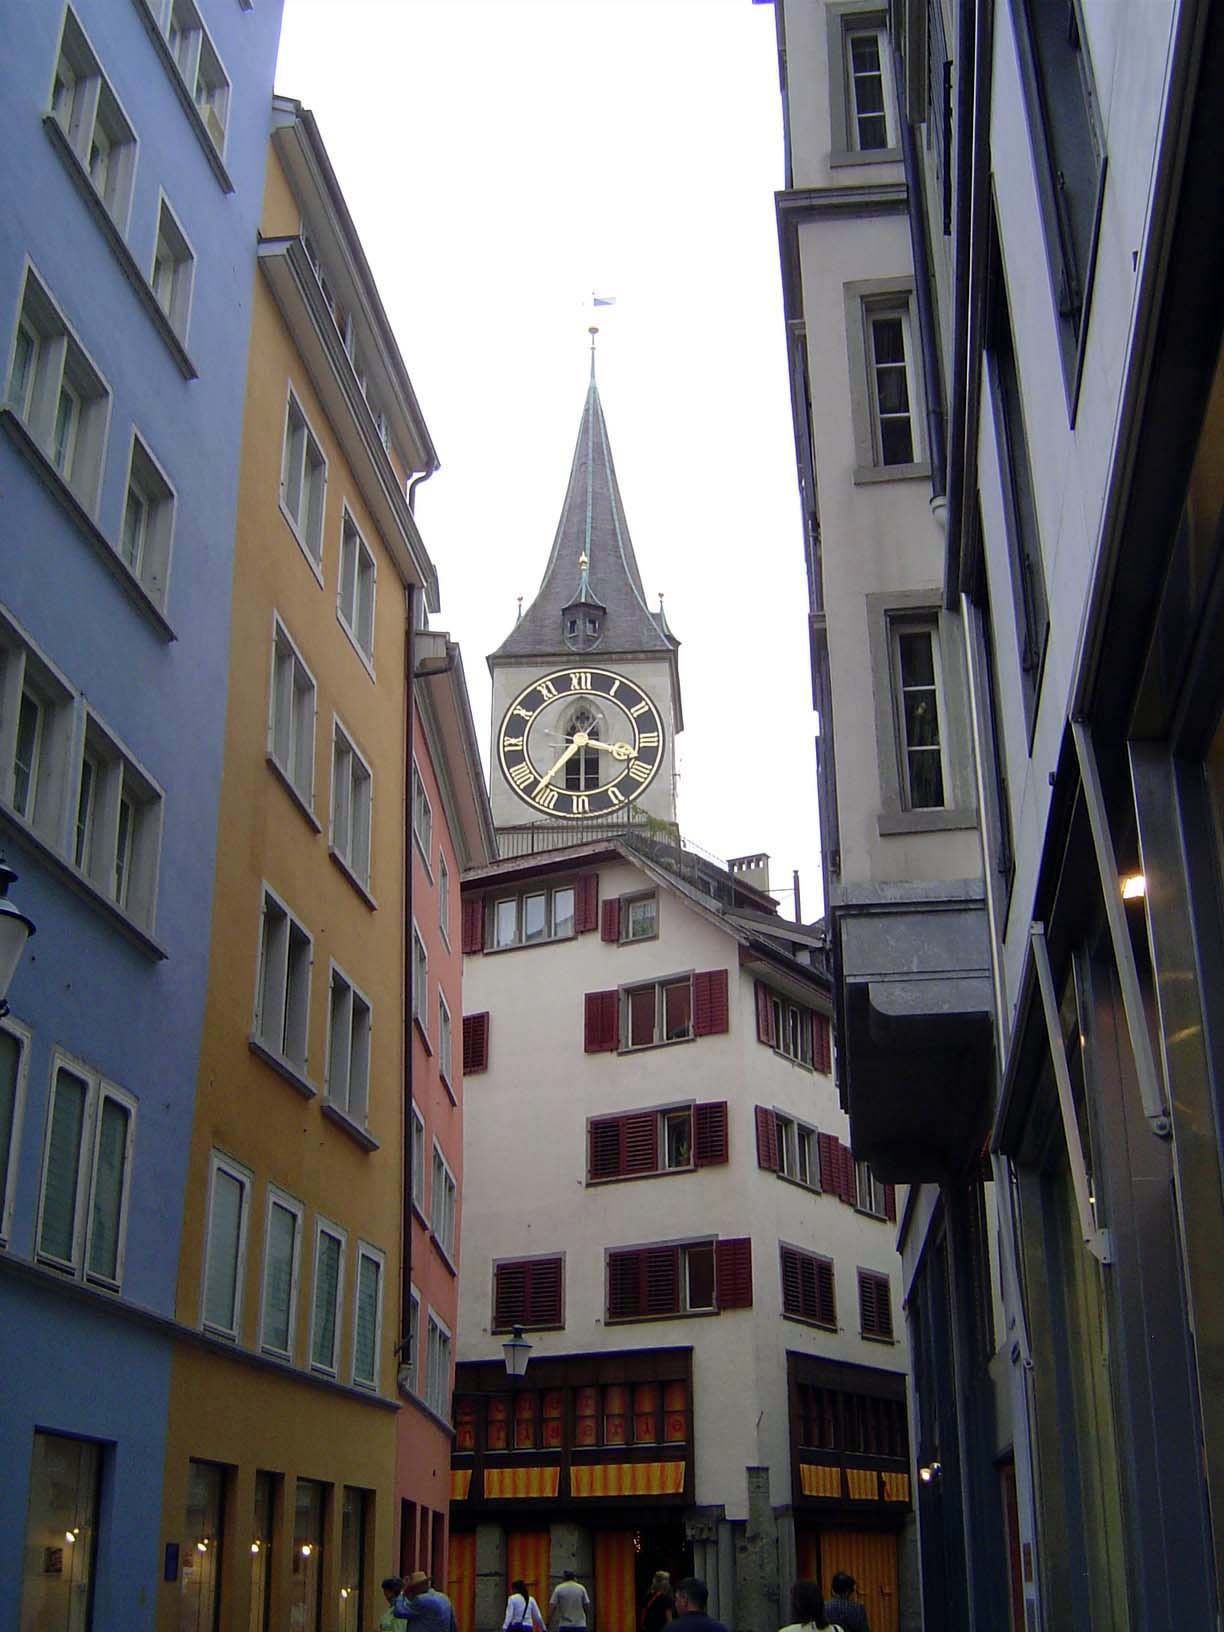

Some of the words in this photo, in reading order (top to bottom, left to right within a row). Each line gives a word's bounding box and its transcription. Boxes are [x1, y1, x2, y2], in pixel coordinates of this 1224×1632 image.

[570, 673, 592, 690] XII
[609, 680, 620, 697] I
[537, 681, 558, 700] XI
[513, 706, 533, 720] X
[504, 736, 523, 752] IX
[639, 732, 659, 747] III
[572, 795, 590, 813] VI
[608, 787, 625, 804] V
